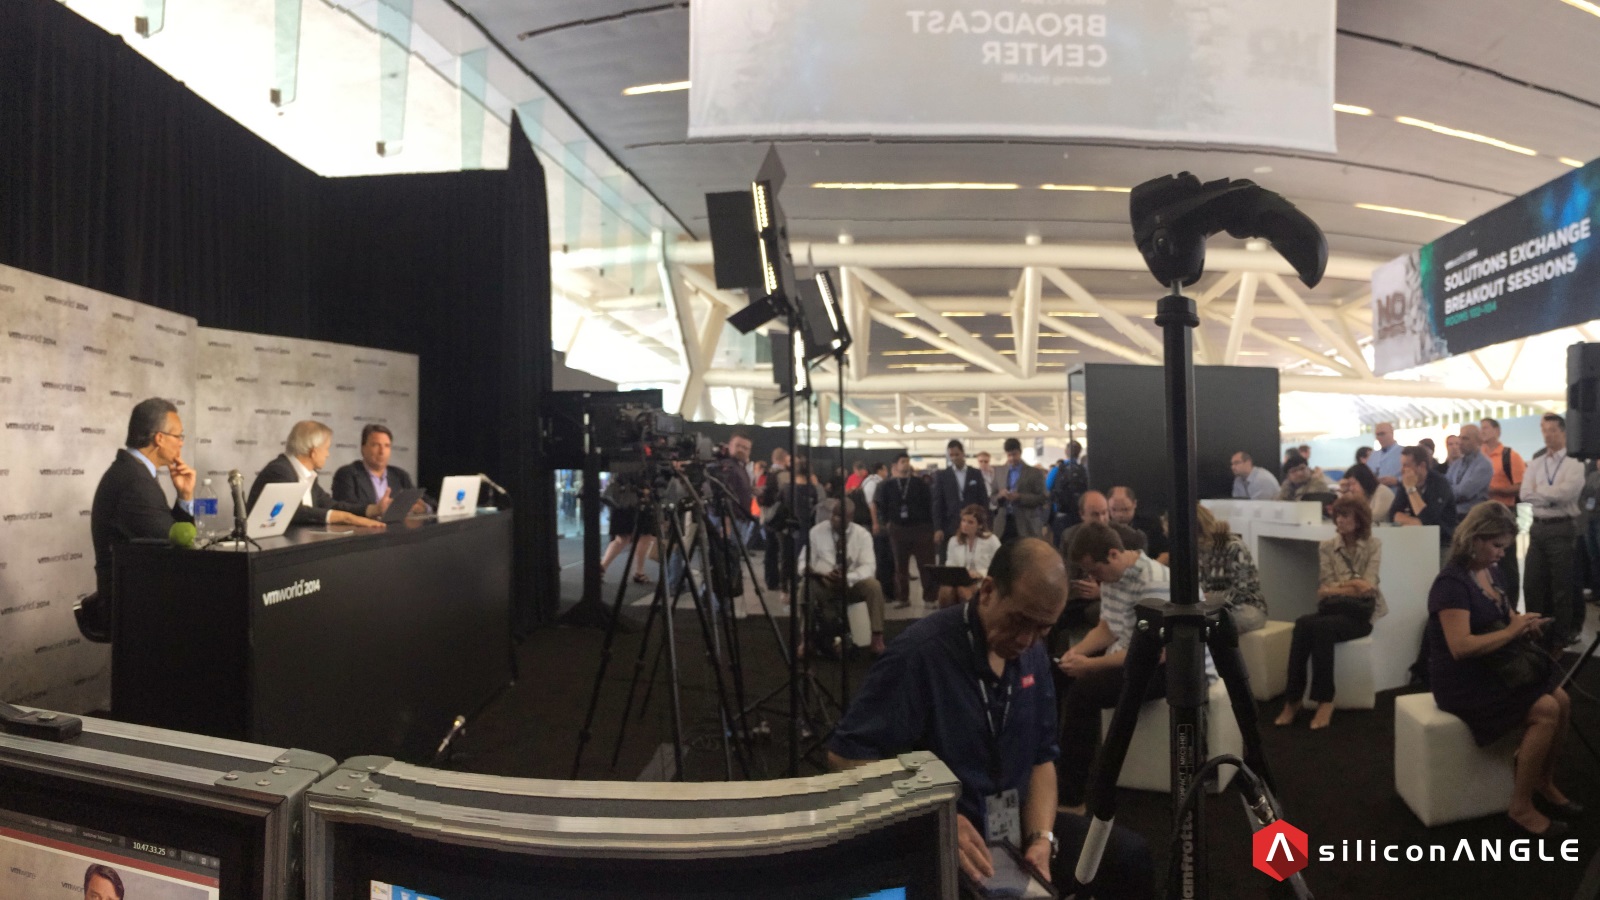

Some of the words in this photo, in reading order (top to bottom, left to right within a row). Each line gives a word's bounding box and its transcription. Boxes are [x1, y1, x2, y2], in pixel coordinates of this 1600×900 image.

[1444, 251, 1508, 292] SOLUTIONS
[1509, 218, 1591, 266] EXCHANGE
[1444, 278, 1505, 315] BREAKOUT
[1507, 252, 1578, 293] SESSIONS
[262, 579, 305, 606] vmworld
[304, 579, 321, 595] 2014
[1179, 772, 1187, 802] OMPACT
[1181, 810, 1195, 900] anfrott
